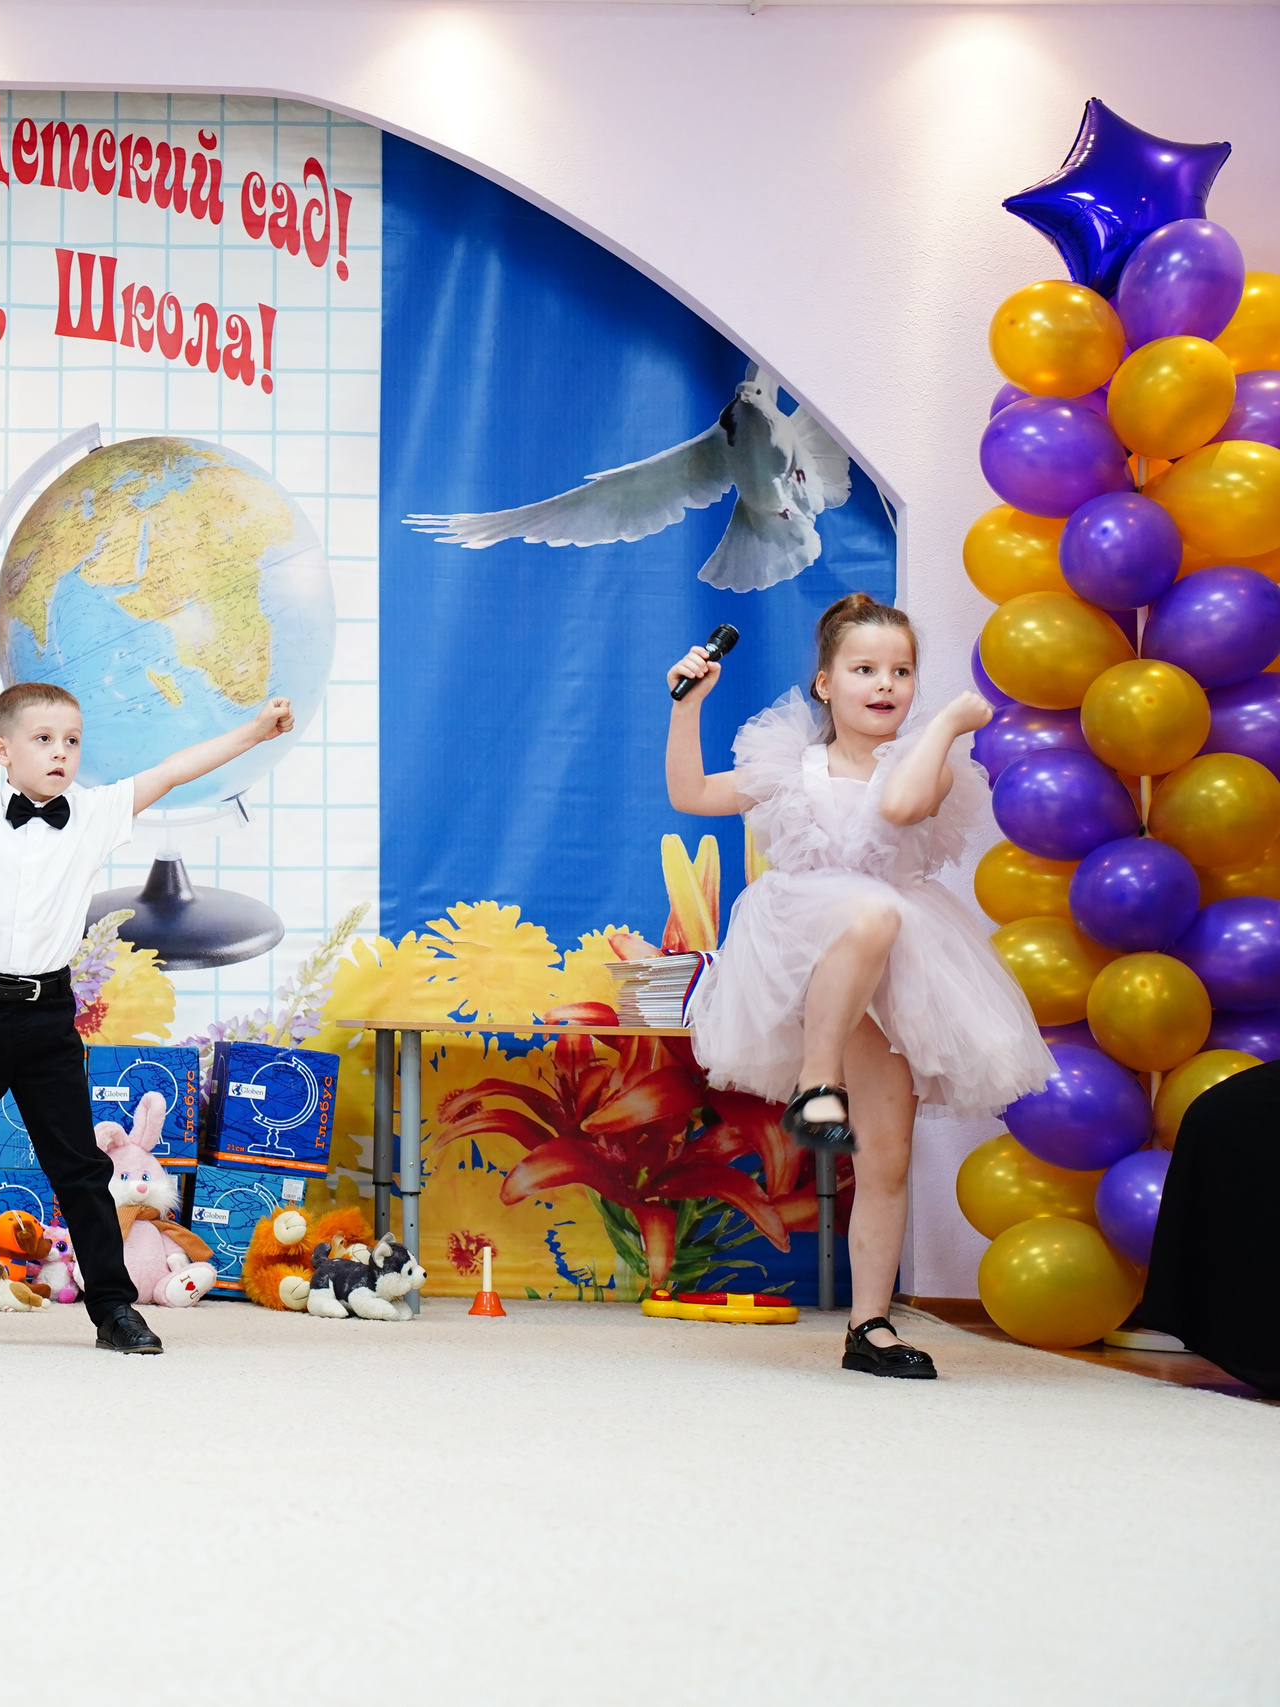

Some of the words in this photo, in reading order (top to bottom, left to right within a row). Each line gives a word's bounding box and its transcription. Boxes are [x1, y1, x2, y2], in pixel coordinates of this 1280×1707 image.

[240, 156, 353, 282] сад!
[54, 248, 277, 395] Школа!
[104, 1089, 128, 1098] Globen
[183, 1070, 197, 1143] Глобус
[240, 1086, 264, 1096] Globen
[315, 1076, 333, 1149] Глобус
[203, 1211, 227, 1221] Globen
[179, 1275, 192, 1284] I
[189, 1288, 200, 1300] U
